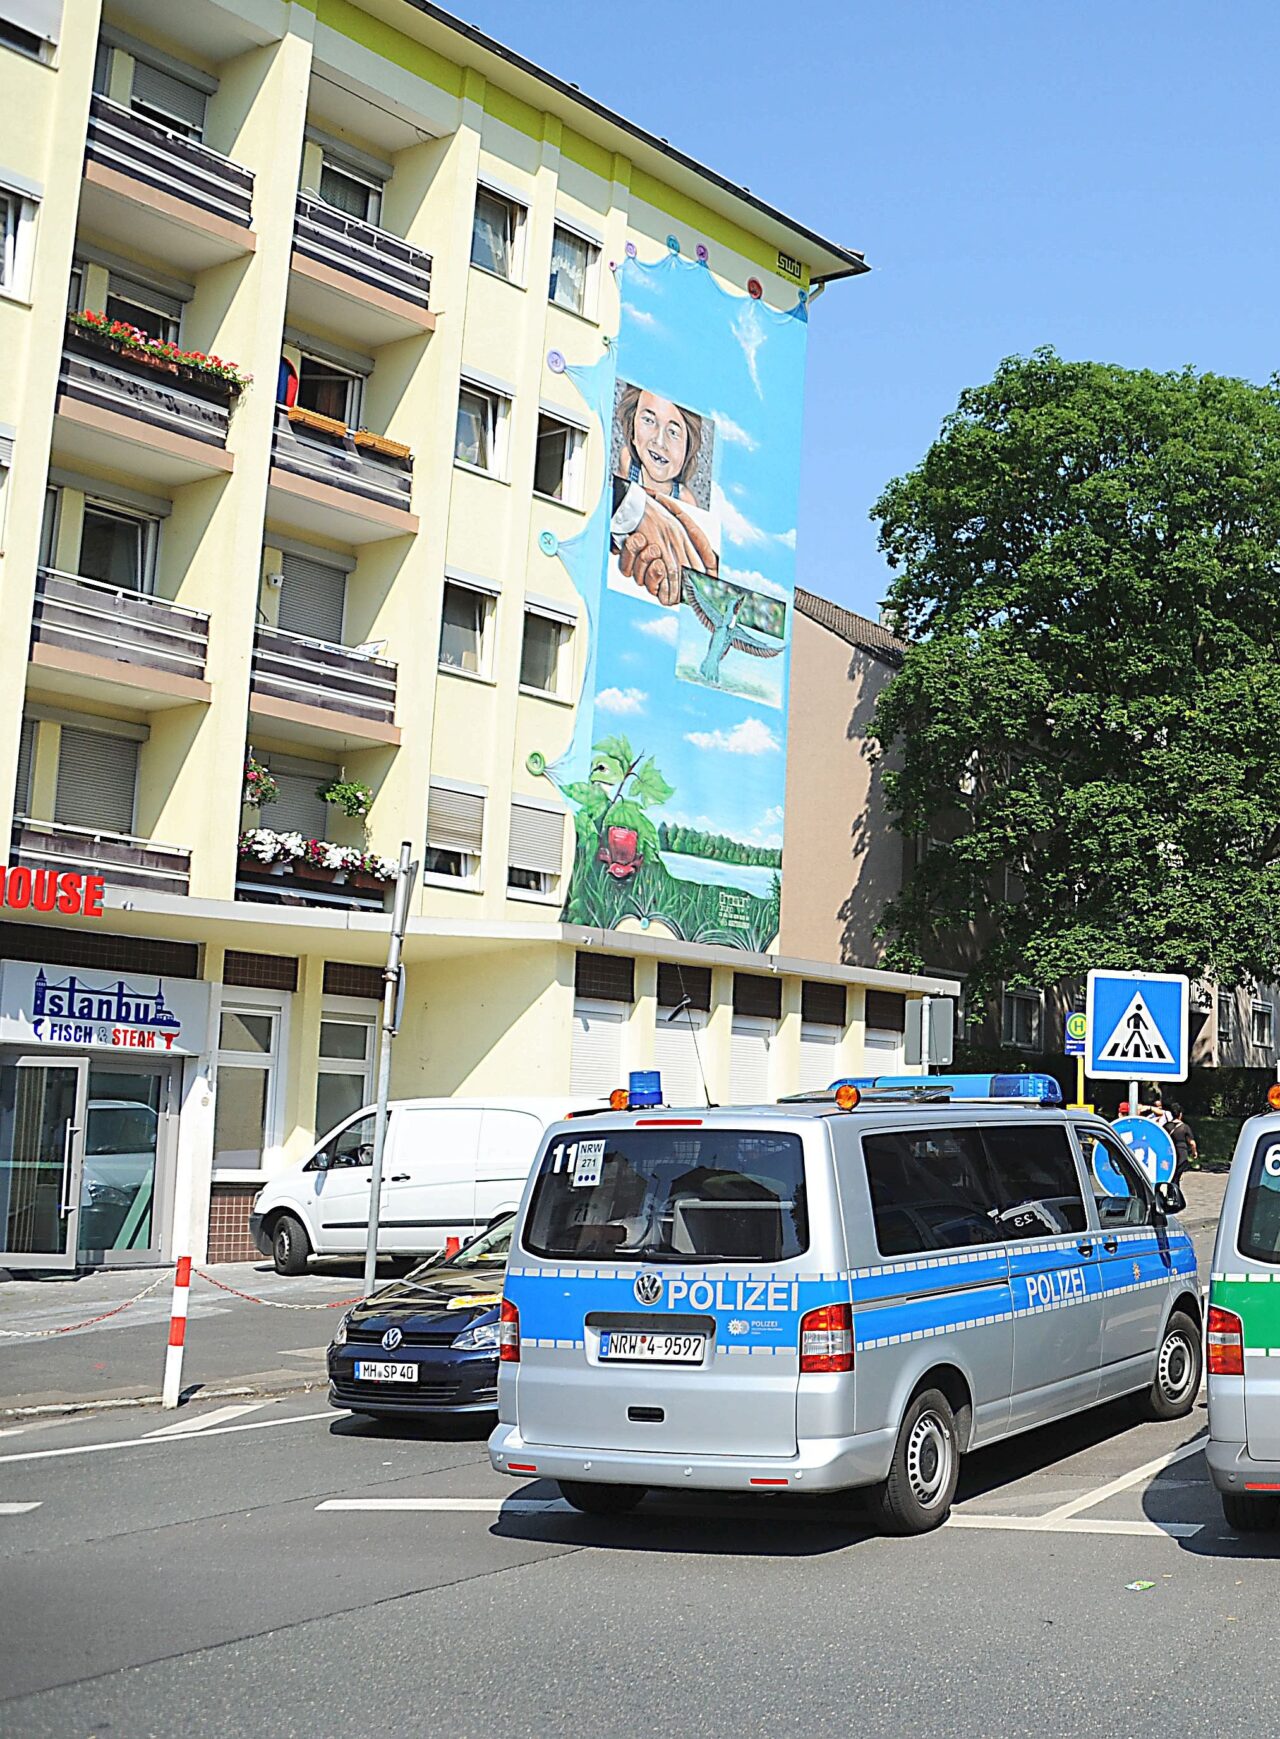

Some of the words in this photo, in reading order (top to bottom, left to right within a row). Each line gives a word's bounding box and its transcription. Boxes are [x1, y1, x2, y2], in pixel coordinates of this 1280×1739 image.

[0, 866, 105, 917] OUSE
[50, 1022, 93, 1044] FISCH
[112, 1028, 156, 1048] STEAK
[553, 1143, 578, 1173] 11
[580, 1143, 602, 1153] NRW
[581, 1158, 596, 1168] 271
[668, 1280, 798, 1311] POLIZEI
[1026, 1267, 1087, 1306] POLIZEI
[610, 1334, 637, 1355] NRW
[647, 1336, 701, 1356] 4-9597
[363, 1366, 377, 1377] MH
[383, 1366, 397, 1379] SP
[400, 1367, 414, 1379] 40
